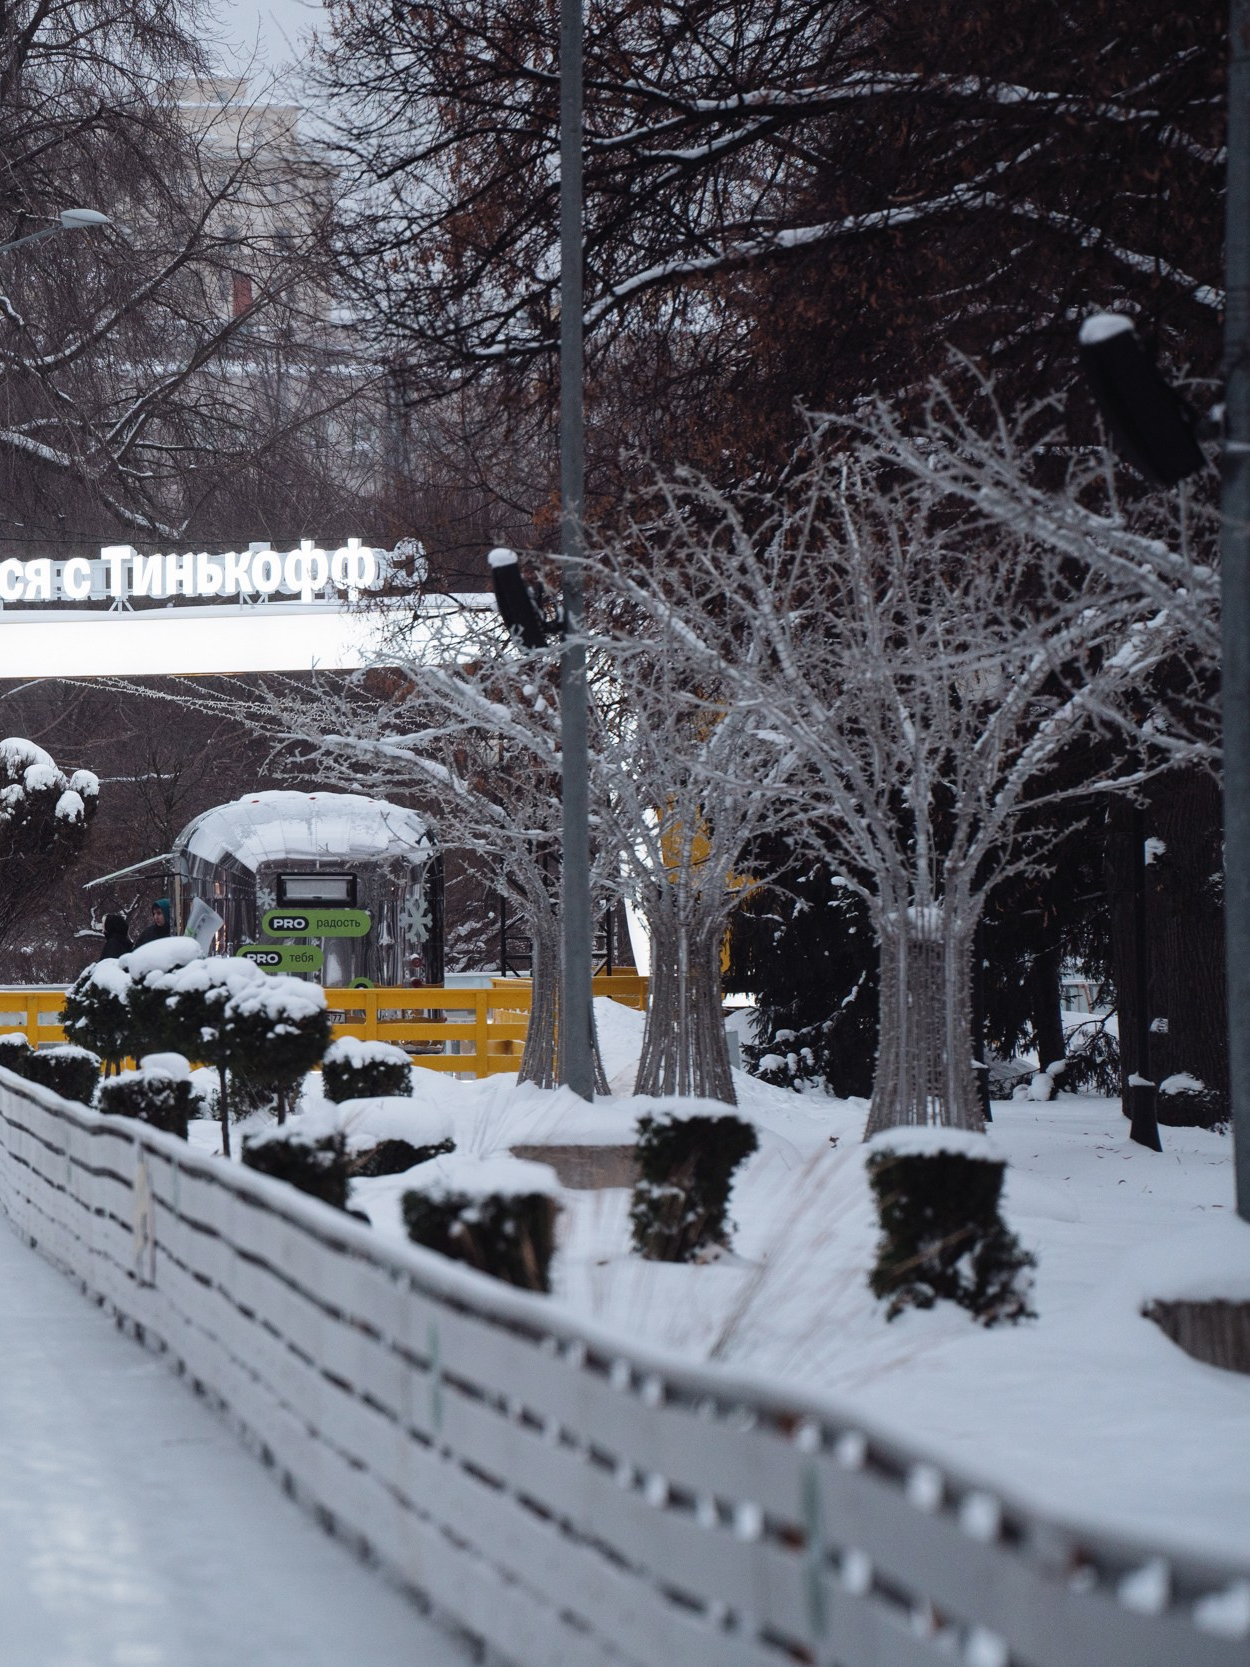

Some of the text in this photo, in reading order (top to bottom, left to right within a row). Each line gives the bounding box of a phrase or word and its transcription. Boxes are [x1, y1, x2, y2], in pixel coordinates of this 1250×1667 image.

[63, 557, 92, 599] с
[100, 537, 378, 603] Тинькофф
[273, 919, 361, 930] PRO радость
[246, 952, 314, 964] PRO тебя
